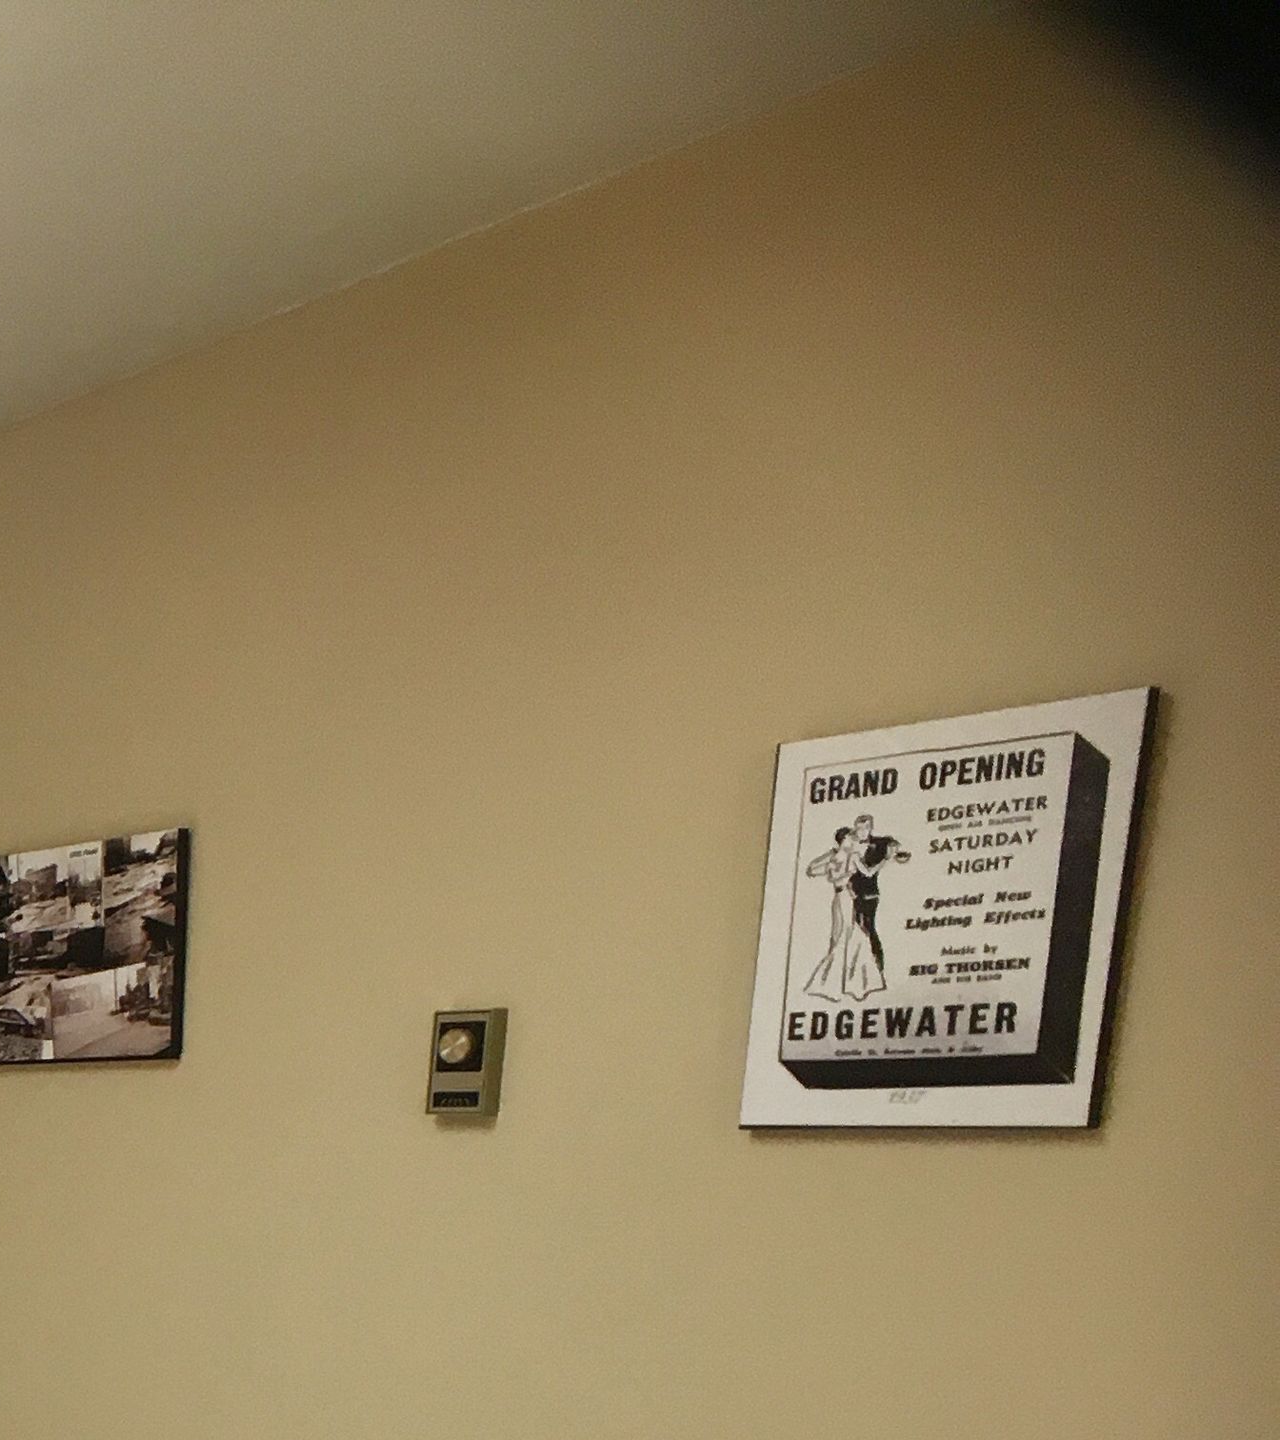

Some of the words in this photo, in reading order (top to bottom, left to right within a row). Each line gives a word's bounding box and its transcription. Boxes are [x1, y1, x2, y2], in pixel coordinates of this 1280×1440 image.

[809, 768, 899, 805] GRAND
[919, 748, 1047, 792] OPENING
[926, 795, 1048, 823] EDGEWATER
[928, 828, 1038, 854] SATURDAY
[947, 854, 1015, 875] NIGHT
[922, 893, 985, 912] Special
[994, 890, 1033, 903] New
[904, 915, 973, 932] Lighting
[983, 908, 1047, 925] Effects
[940, 944, 976, 957] Music
[944, 957, 1032, 975] THORSEN
[787, 1001, 1018, 1041] EDGEWATER
